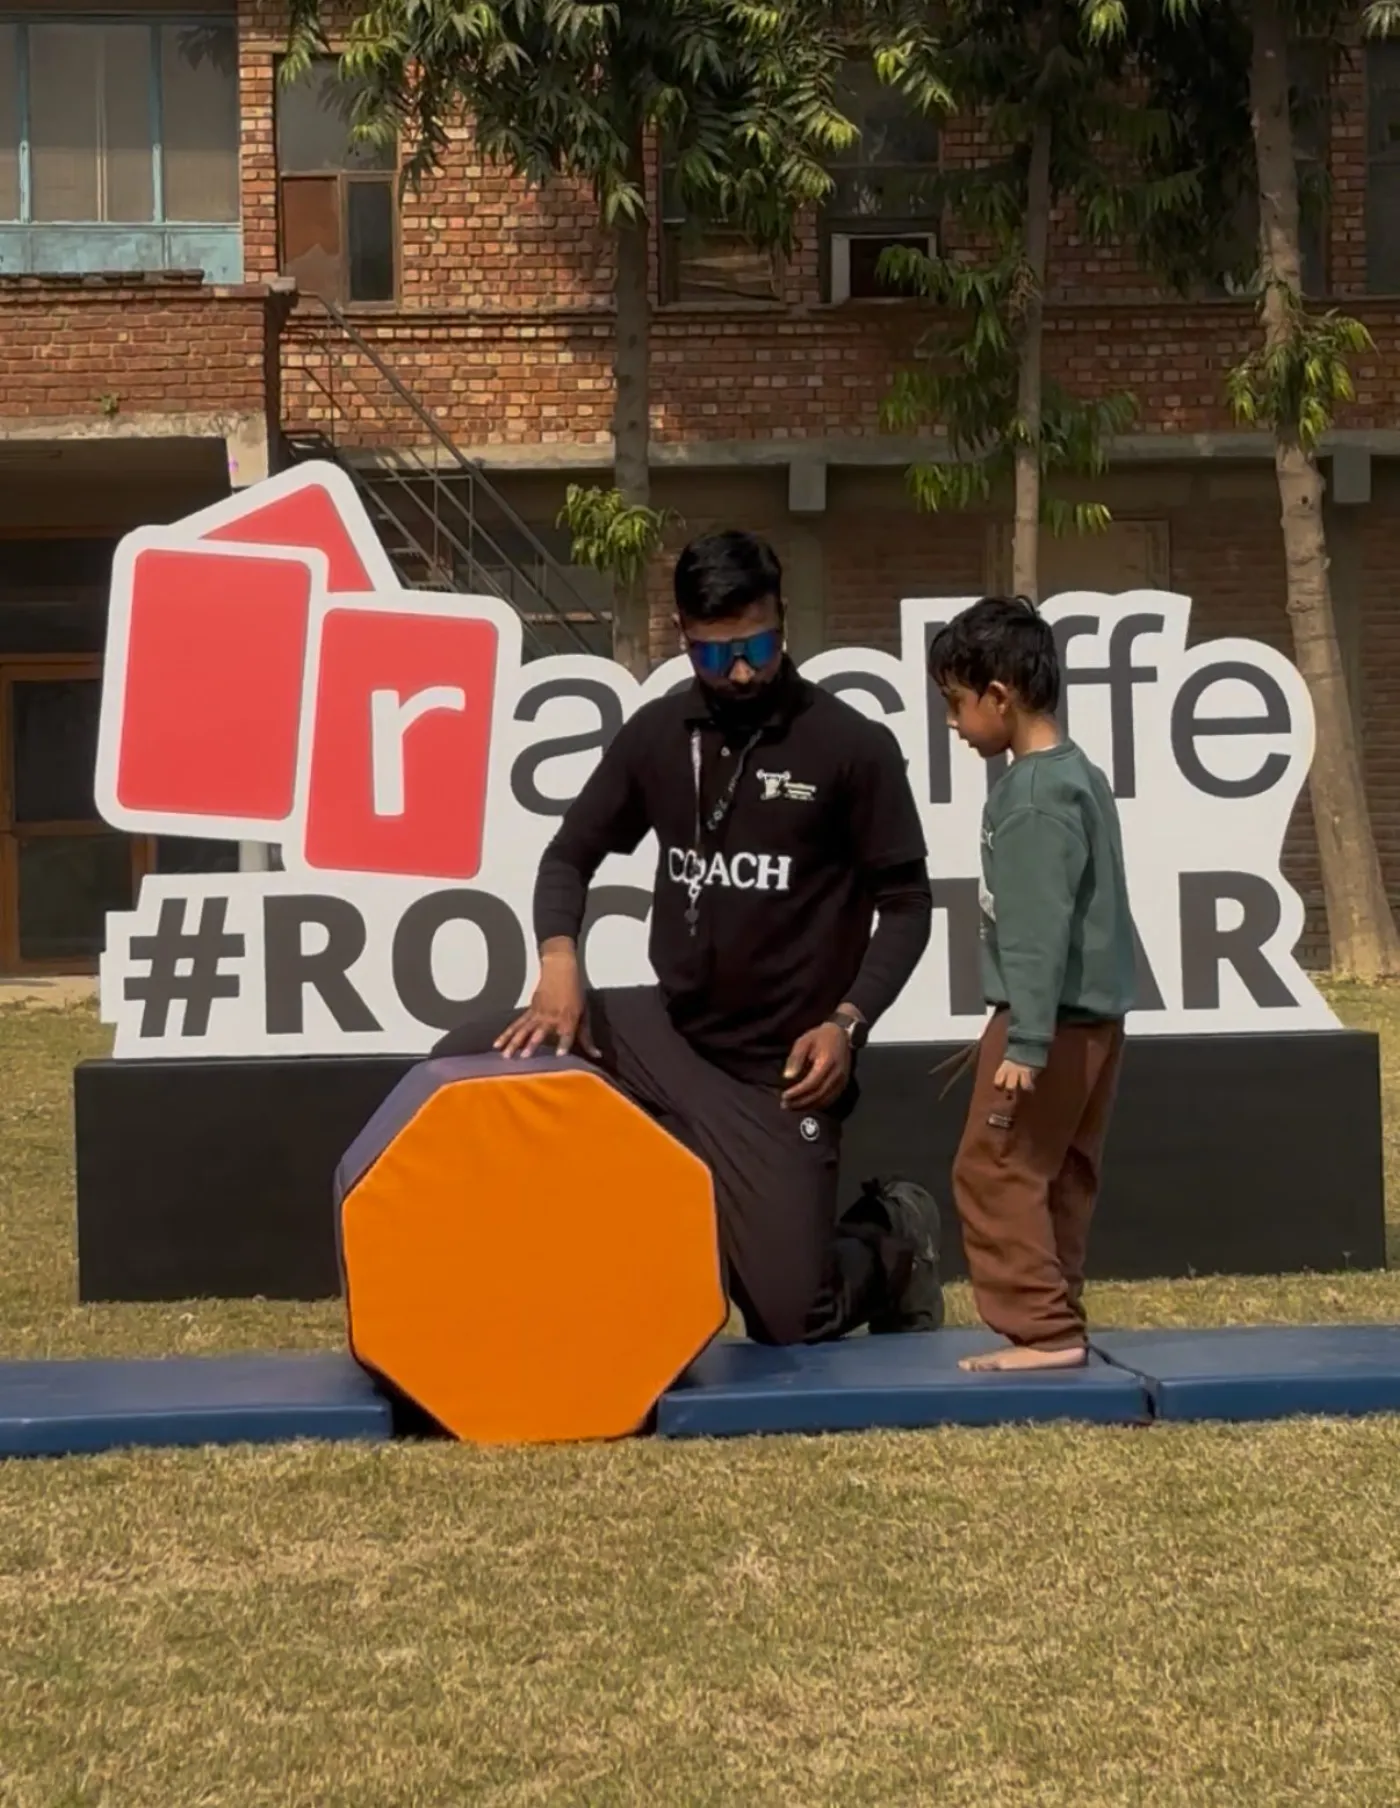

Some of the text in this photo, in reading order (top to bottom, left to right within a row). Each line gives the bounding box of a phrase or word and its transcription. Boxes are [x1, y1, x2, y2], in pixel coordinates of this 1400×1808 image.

[371, 612, 1292, 817] ralffe
[668, 847, 792, 890] COACH
[123, 870, 1301, 1038] #ROCTR
